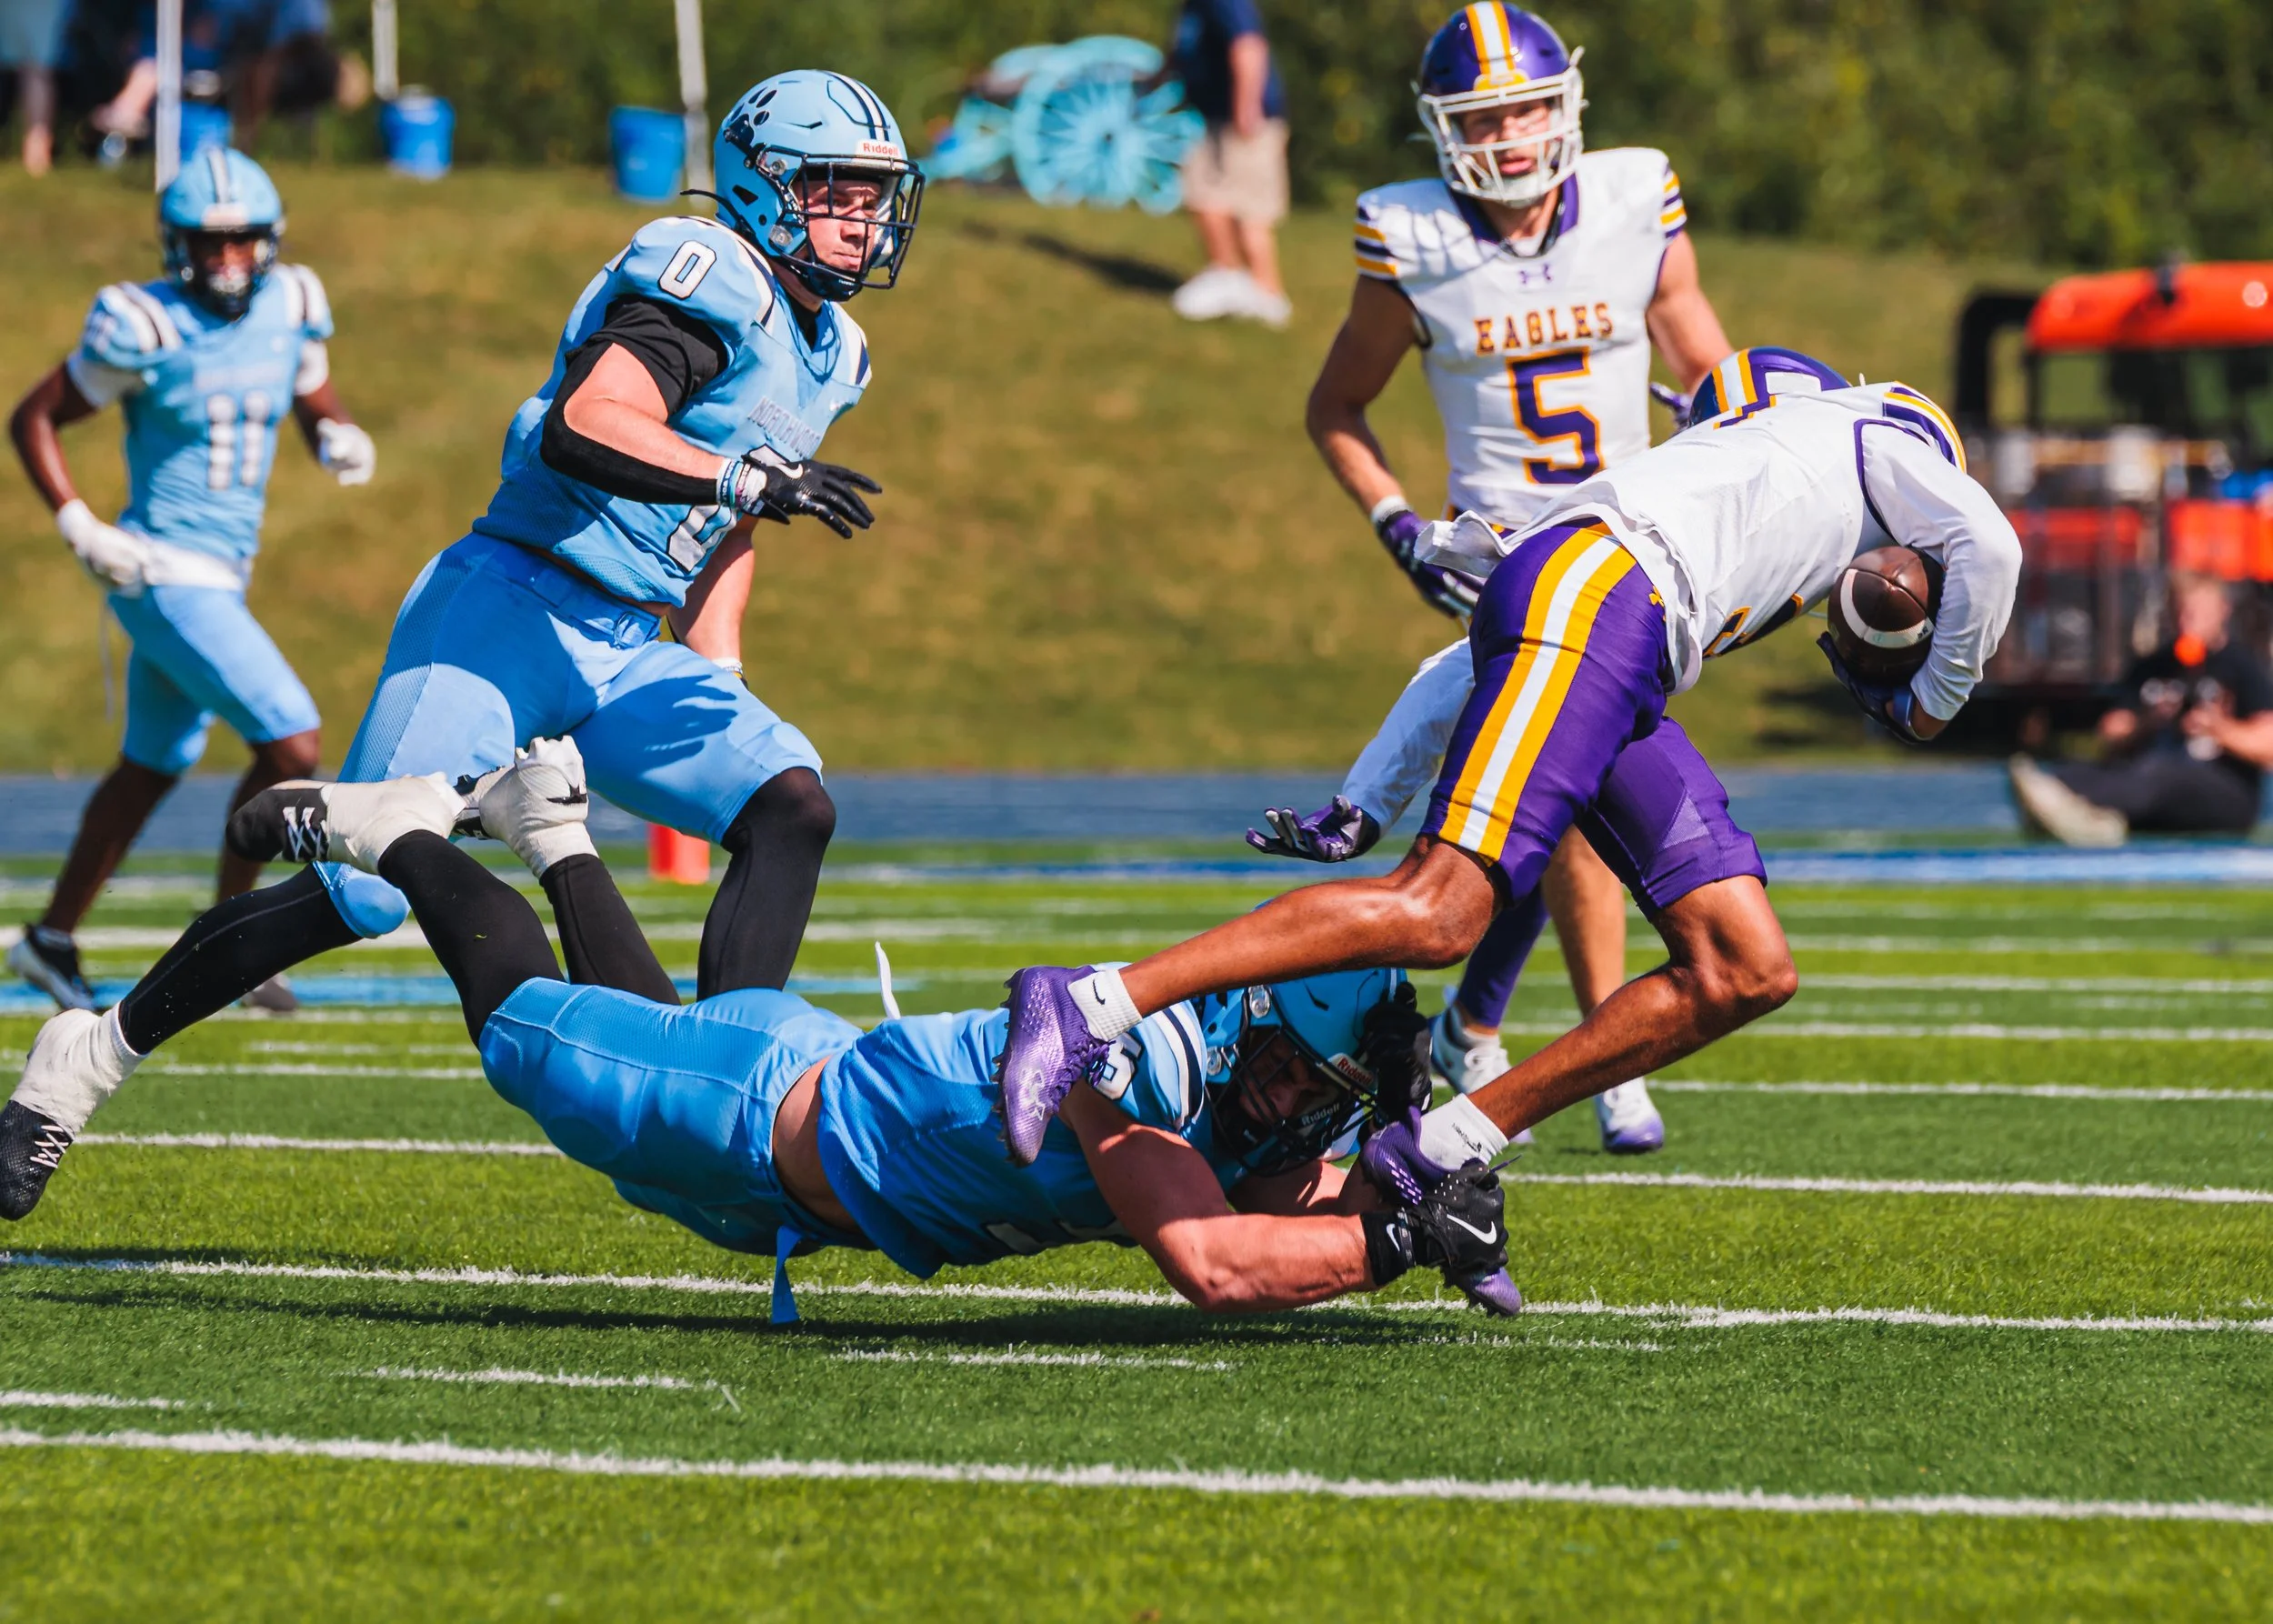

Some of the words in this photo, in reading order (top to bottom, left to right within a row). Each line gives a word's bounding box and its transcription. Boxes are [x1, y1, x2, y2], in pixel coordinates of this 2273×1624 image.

[863, 142, 898, 156] Riddell
[657, 240, 717, 301] 0
[1474, 302, 1613, 357] EAGLES
[206, 392, 271, 490] 11
[1505, 345, 1607, 485] 5
[1337, 1057, 1376, 1087] Riddell
[1301, 1102, 1340, 1126] Riddell
